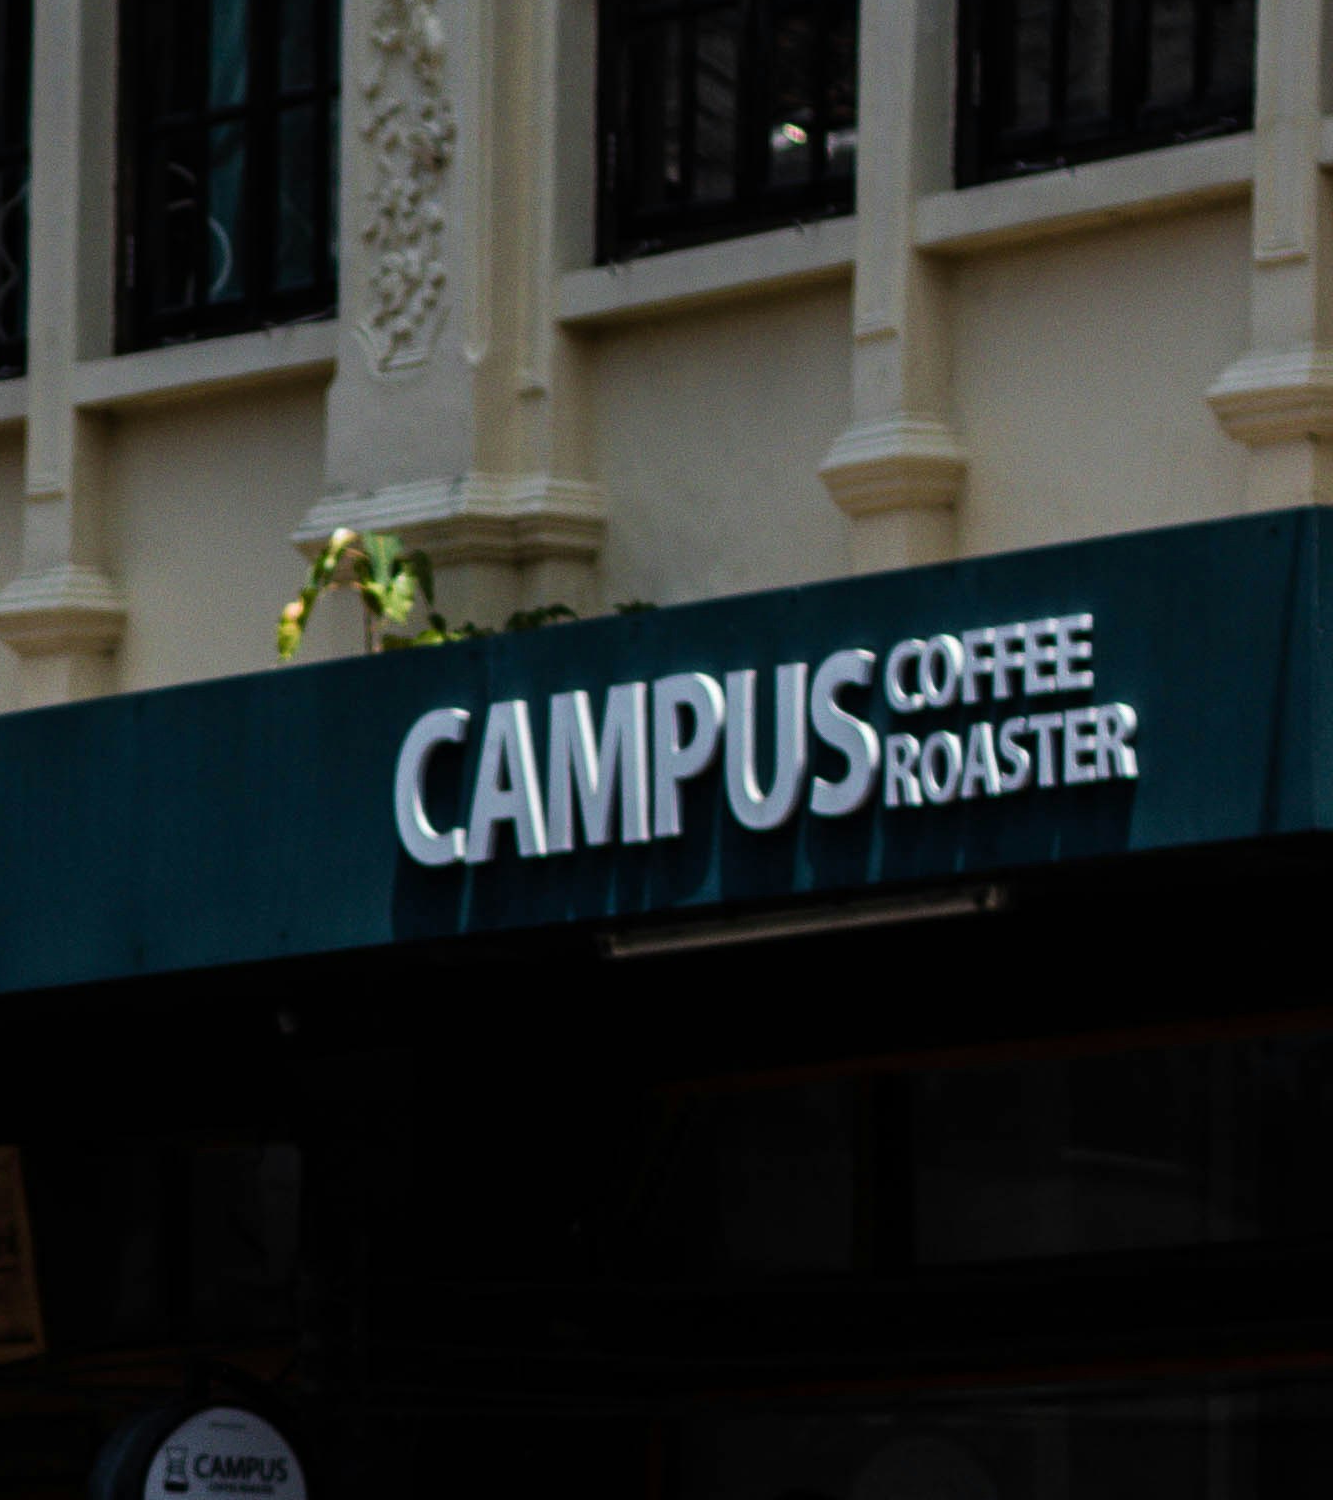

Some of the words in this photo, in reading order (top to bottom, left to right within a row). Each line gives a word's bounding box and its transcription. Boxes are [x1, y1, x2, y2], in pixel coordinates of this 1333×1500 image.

[885, 612, 1096, 714] COFFEE
[394, 647, 882, 867] CAMPUS
[885, 700, 1139, 809] ROASTER
[193, 1453, 289, 1483] CAMPUS
